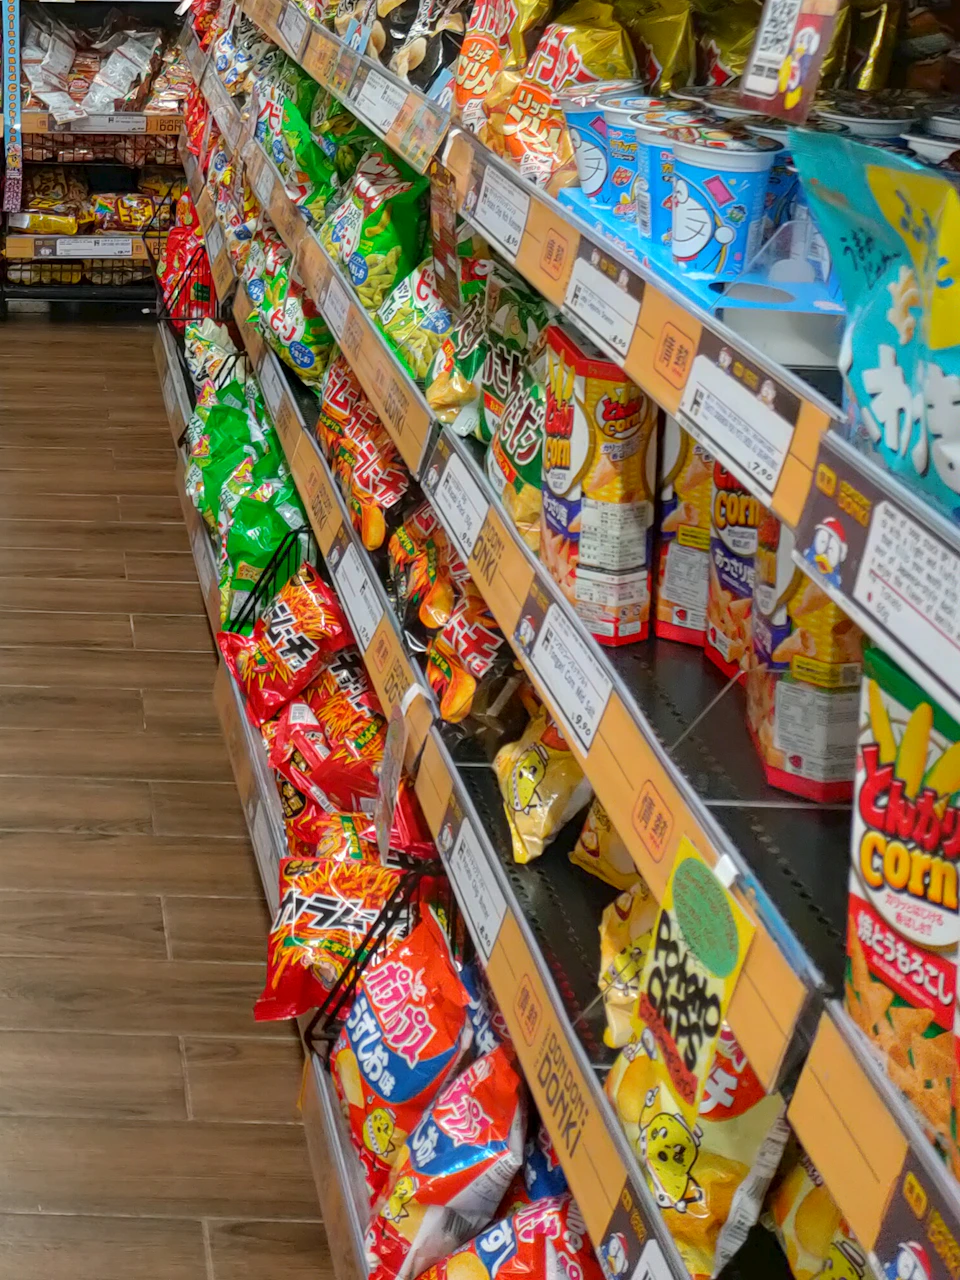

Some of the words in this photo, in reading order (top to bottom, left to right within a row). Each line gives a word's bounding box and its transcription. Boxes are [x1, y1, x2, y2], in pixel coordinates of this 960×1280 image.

[471, 536, 499, 587] ONKI
[575, 713, 592, 737] 9.90
[537, 1049, 584, 1159] DONKI
